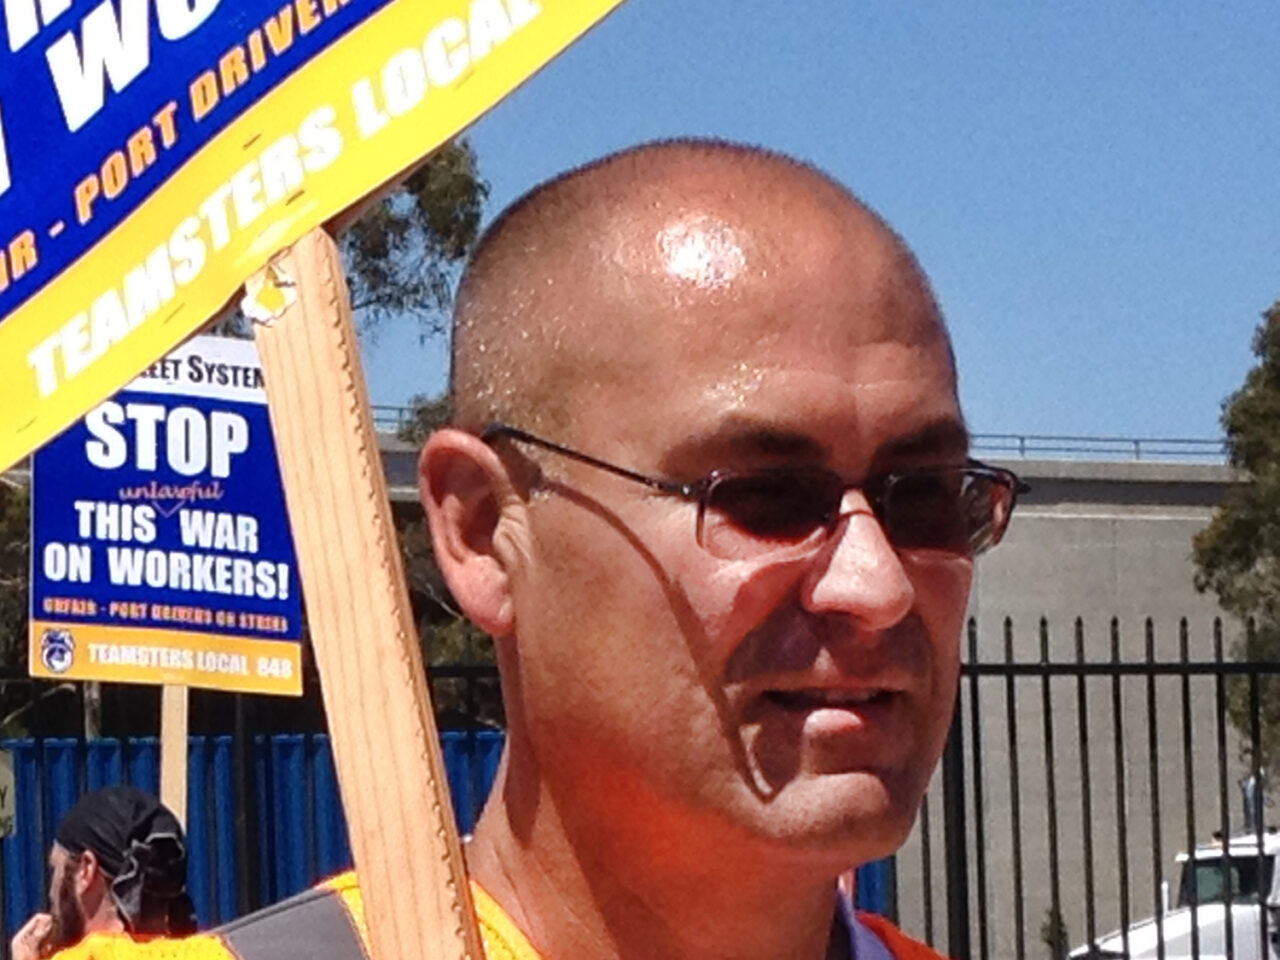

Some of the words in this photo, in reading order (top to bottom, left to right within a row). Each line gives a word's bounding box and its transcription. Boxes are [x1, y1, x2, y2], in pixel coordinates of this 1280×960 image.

[74, 101, 178, 225] PORT
[189, 0, 350, 122] DRIVE
[27, 105, 344, 397] TEAMSTERS
[188, 354, 266, 389] SYSTEM
[85, 400, 249, 478] STOP
[119, 481, 224, 502] unlawful
[74, 500, 157, 543] THIS
[179, 509, 259, 553] WAR
[43, 542, 92, 583] ON
[108, 548, 289, 600] WORKERS!
[109, 602, 147, 619] PORT
[88, 643, 194, 671] TEAMSTERS
[197, 652, 249, 676] LOCAL
[256, 657, 293, 679] 848
